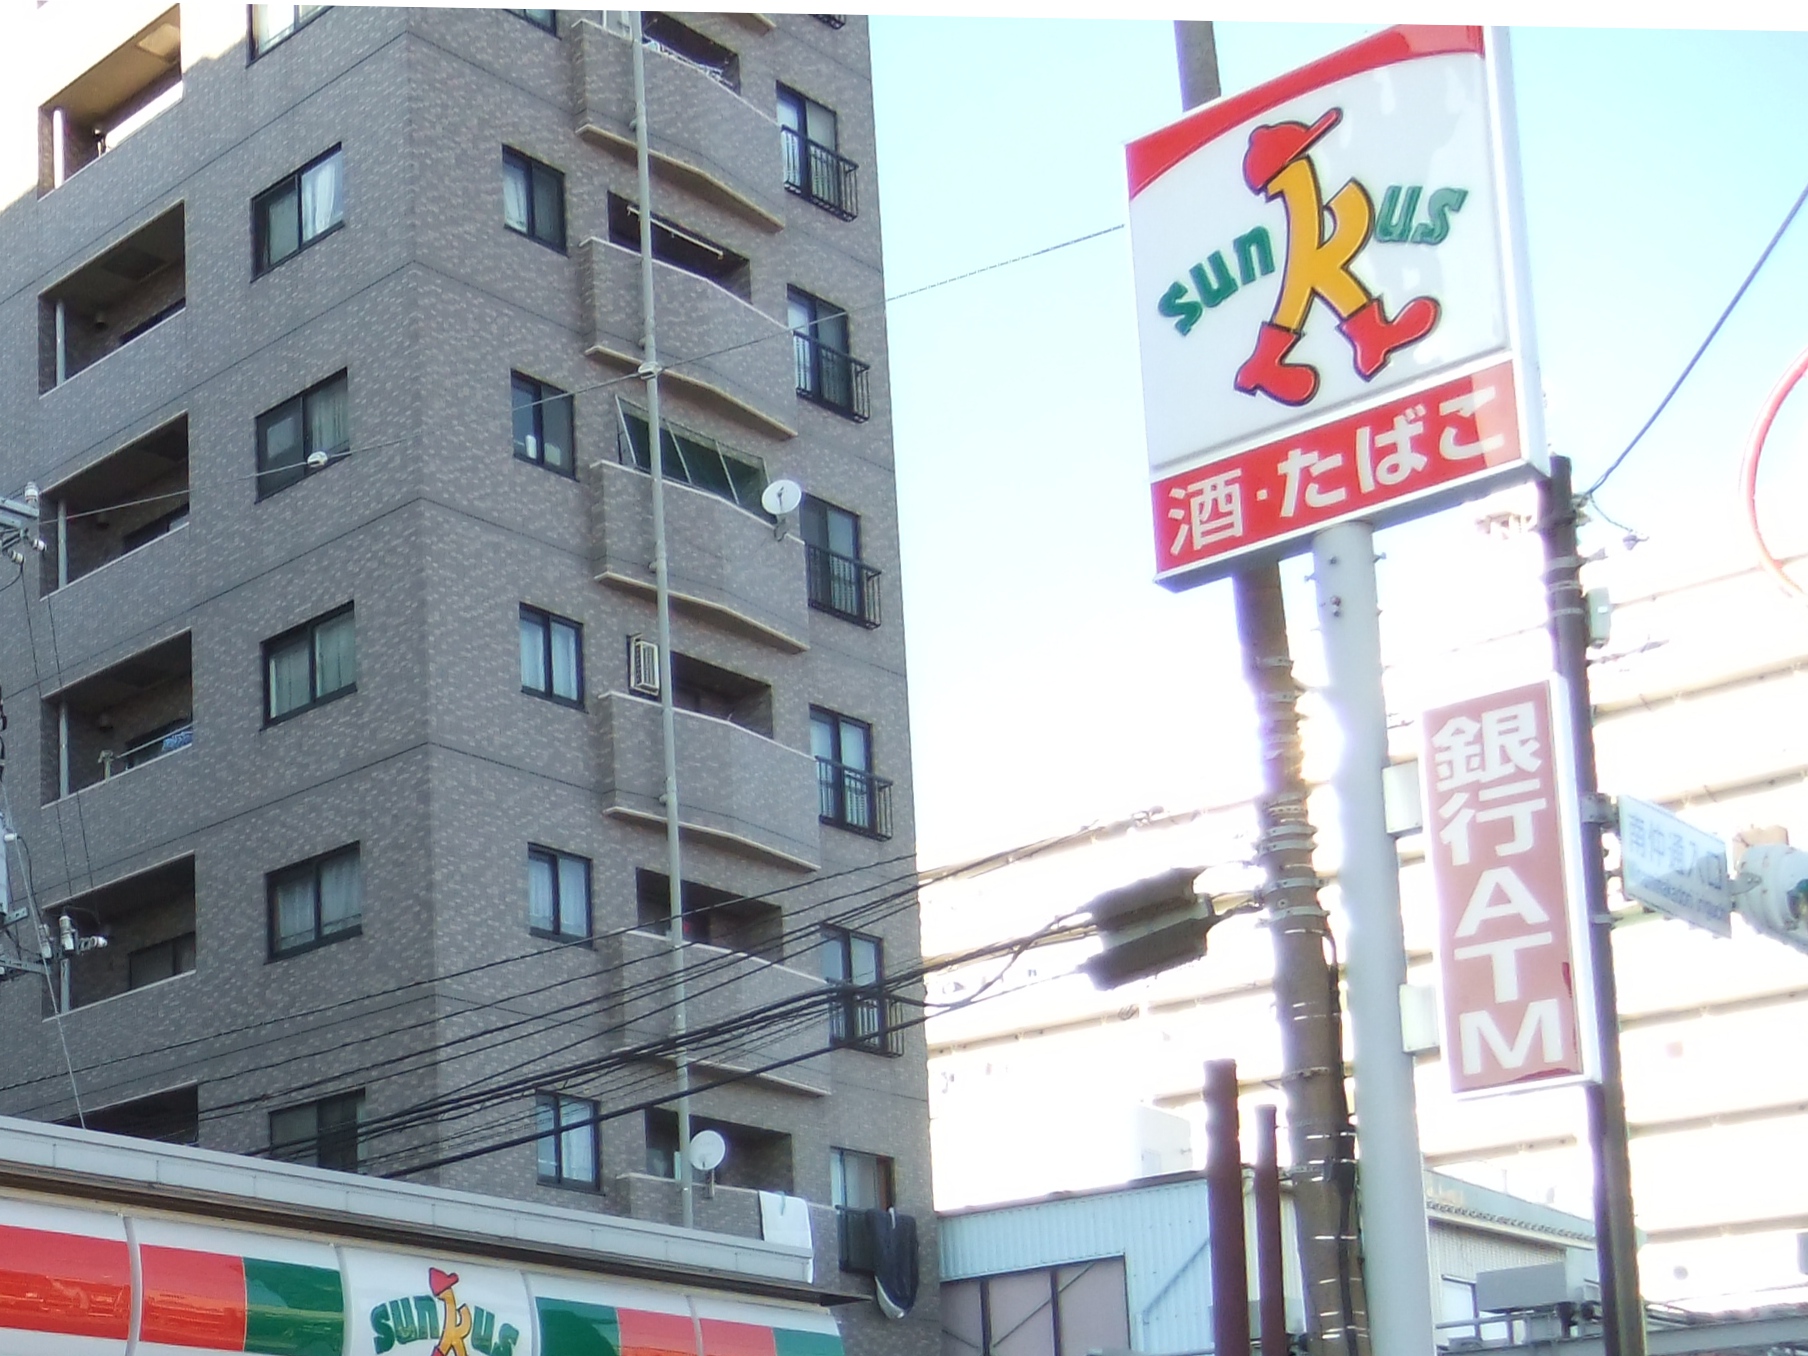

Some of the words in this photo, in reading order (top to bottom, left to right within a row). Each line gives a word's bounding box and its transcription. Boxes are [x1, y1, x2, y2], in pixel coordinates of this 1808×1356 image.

[1167, 387, 1506, 557] 酒・たばこ
[1430, 700, 1564, 1076] 銀行ATM
